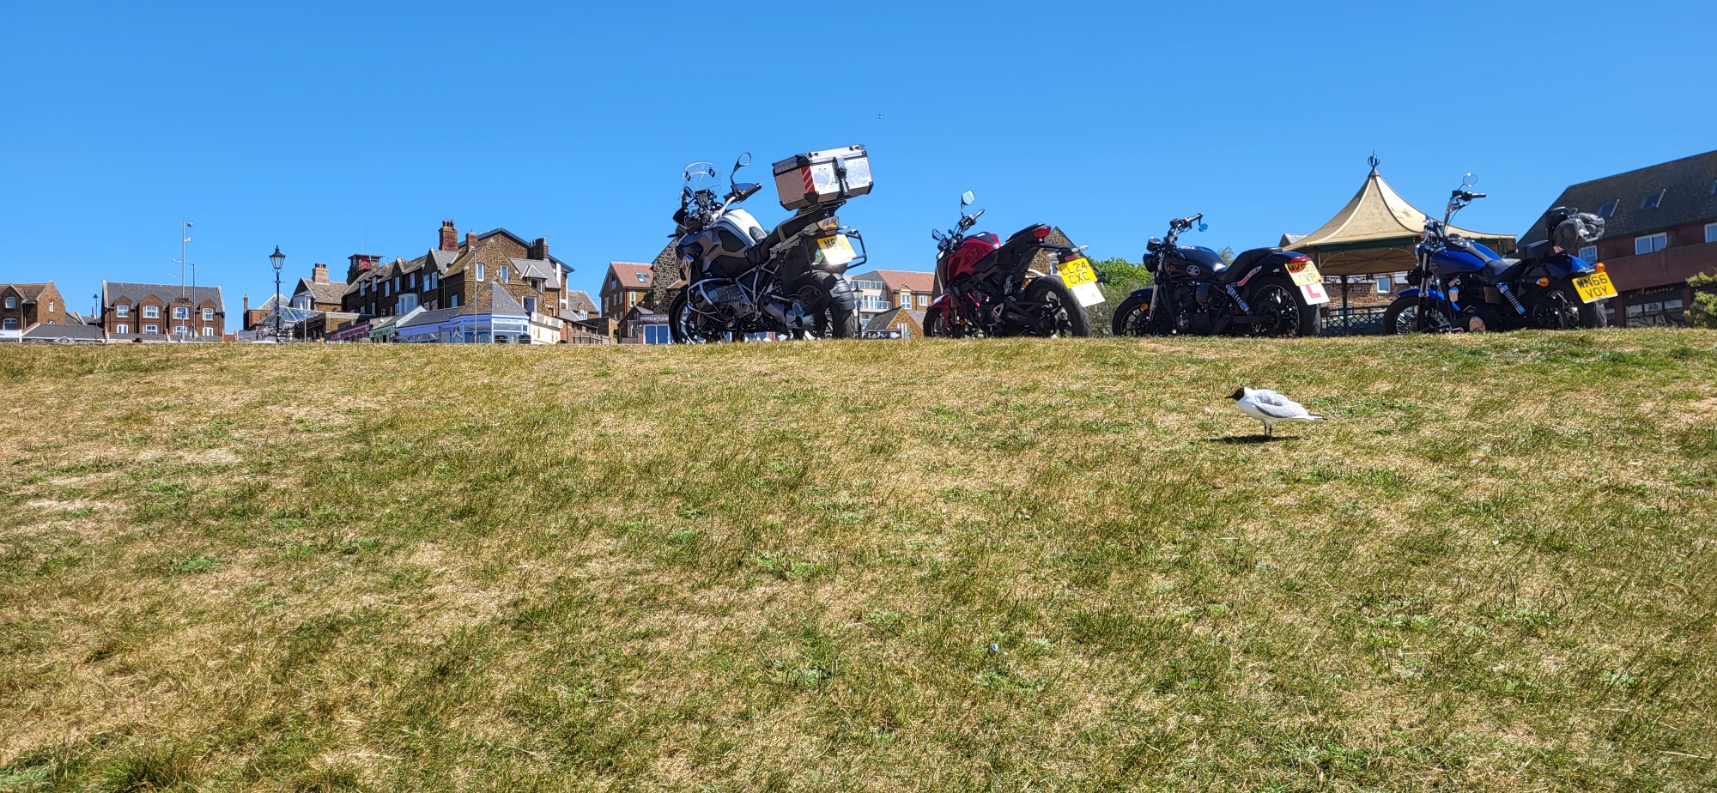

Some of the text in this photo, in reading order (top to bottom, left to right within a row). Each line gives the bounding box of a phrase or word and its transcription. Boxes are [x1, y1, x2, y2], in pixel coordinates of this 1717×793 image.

[1059, 261, 1088, 276] LL24
[1068, 271, 1090, 284] CXC
[1576, 274, 1608, 289] WN66
[1305, 284, 1322, 299] L
[1585, 285, 1608, 298] VOY
